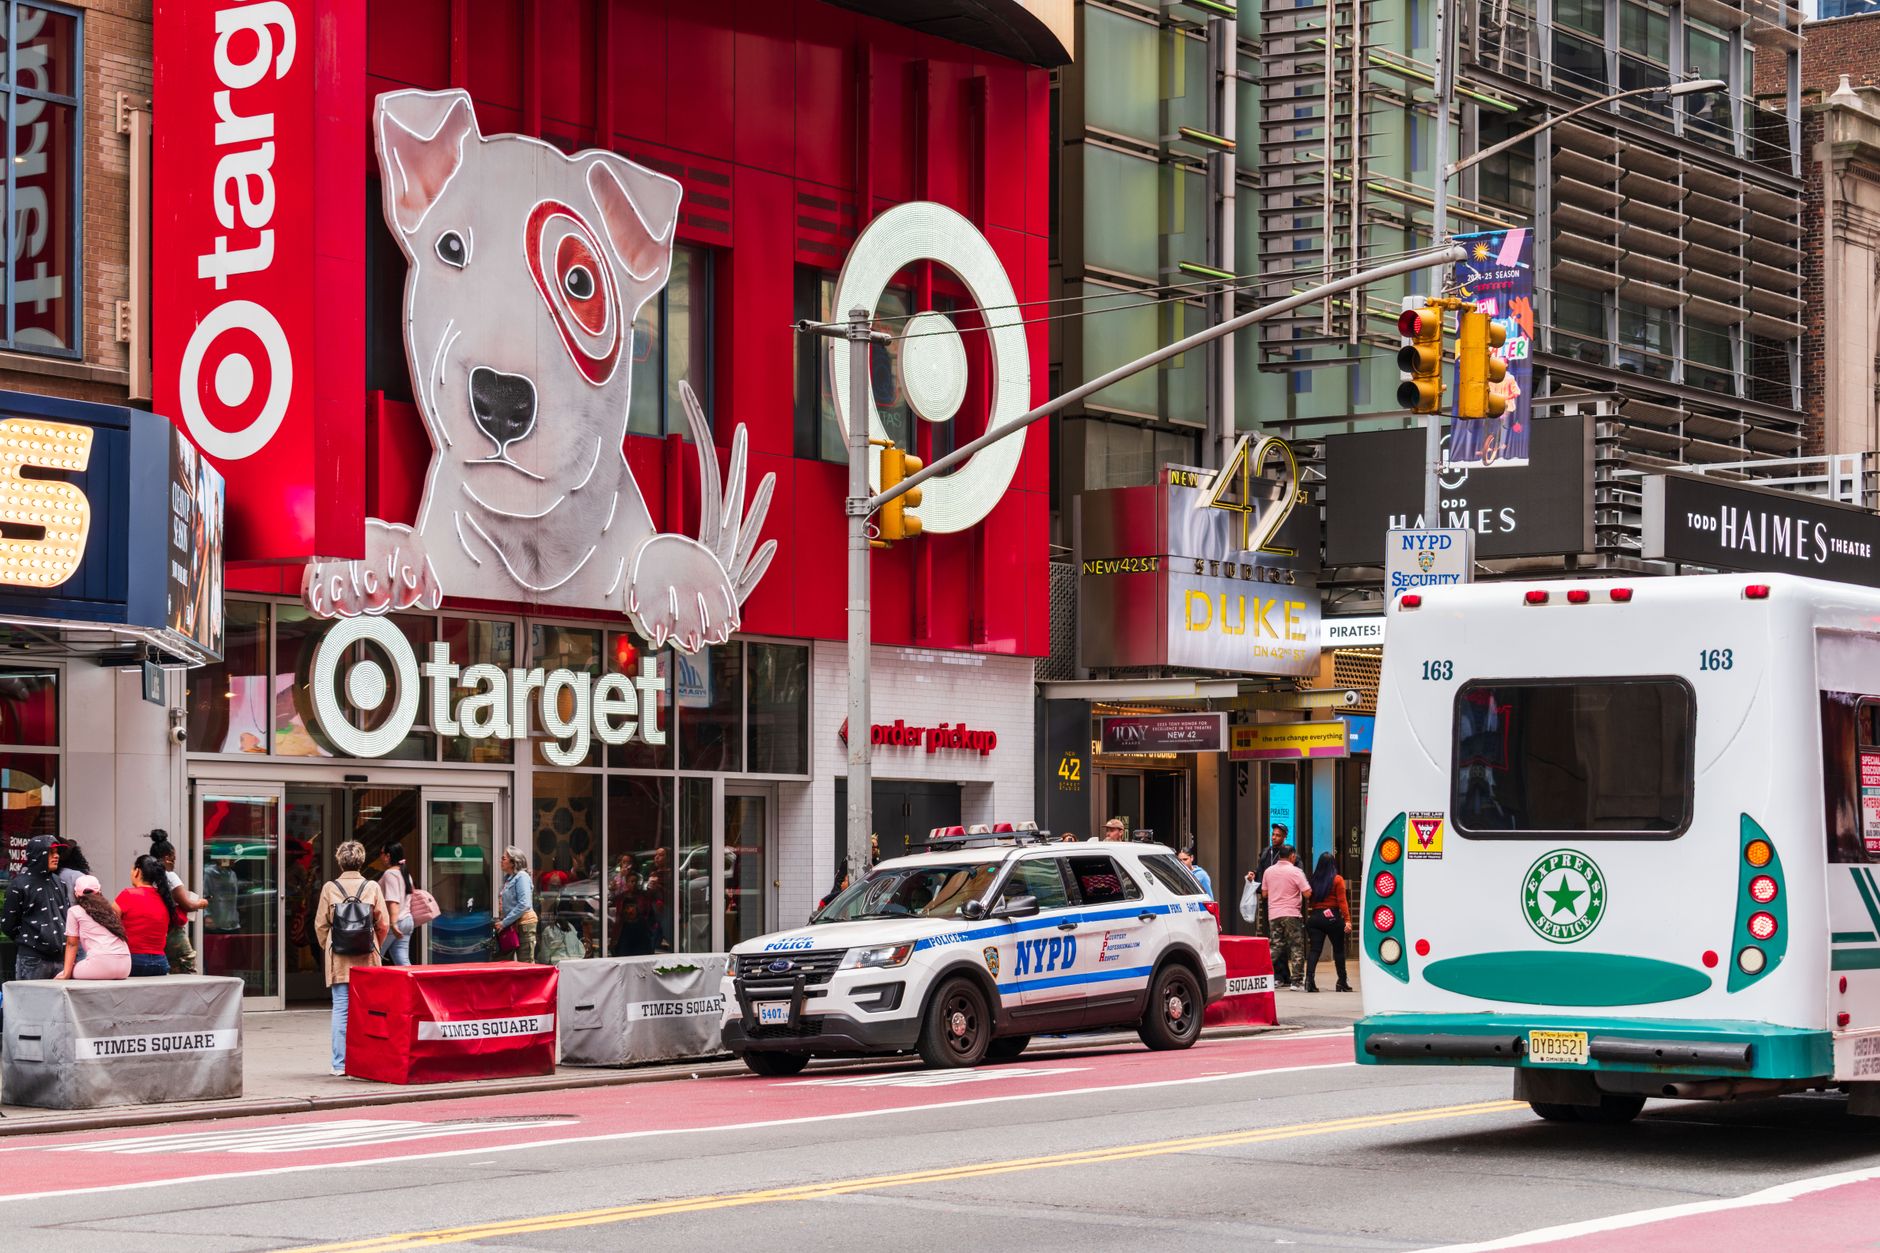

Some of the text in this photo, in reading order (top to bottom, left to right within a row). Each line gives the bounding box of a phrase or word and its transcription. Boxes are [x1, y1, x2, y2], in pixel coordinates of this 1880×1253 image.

[1495, 270, 1520, 279] SEASON
[1171, 470, 1199, 487] NEW
[1203, 435, 1299, 557] 42
[1441, 499, 1467, 509] ODD
[1389, 507, 1516, 534] HAMES
[1401, 535, 1452, 550] NYPD
[1687, 505, 1871, 564] TODD HAIMES THEATRE
[1193, 559, 1296, 585] STUDIOS
[1391, 571, 1460, 587] SECURITY
[1184, 589, 1307, 642] DUKE
[1329, 625, 1381, 638] PIRATES!
[1253, 645, 1269, 657] ON
[1292, 649, 1306, 662] ST
[1699, 648, 1733, 671] 163
[1422, 660, 1454, 681] 163
[421, 641, 666, 767] target
[871, 719, 997, 756] order pickup
[1112, 725, 1148, 740] TONY
[1167, 731, 1197, 739] NEW 42
[1286, 735, 1309, 743] change
[1309, 732, 1343, 741] everything
[1091, 740, 1102, 756] EW
[1058, 758, 1081, 780] 42
[1270, 807, 1290, 816] PIRATES!
[1527, 854, 1601, 894] EXPRESS
[1536, 915, 1592, 937] SERVICE
[764, 941, 814, 951] POLICE
[928, 932, 960, 948] POLICE
[1013, 935, 1077, 977] NYPD
[1228, 977, 1268, 993] SQUARE
[641, 998, 721, 1017] TIMES SQUAR
[761, 1008, 782, 1020] 5407
[440, 1018, 539, 1039] TIMES SQUARE
[93, 1034, 215, 1056] TIMES SQUARE
[1532, 1038, 1583, 1056] OYB3521
